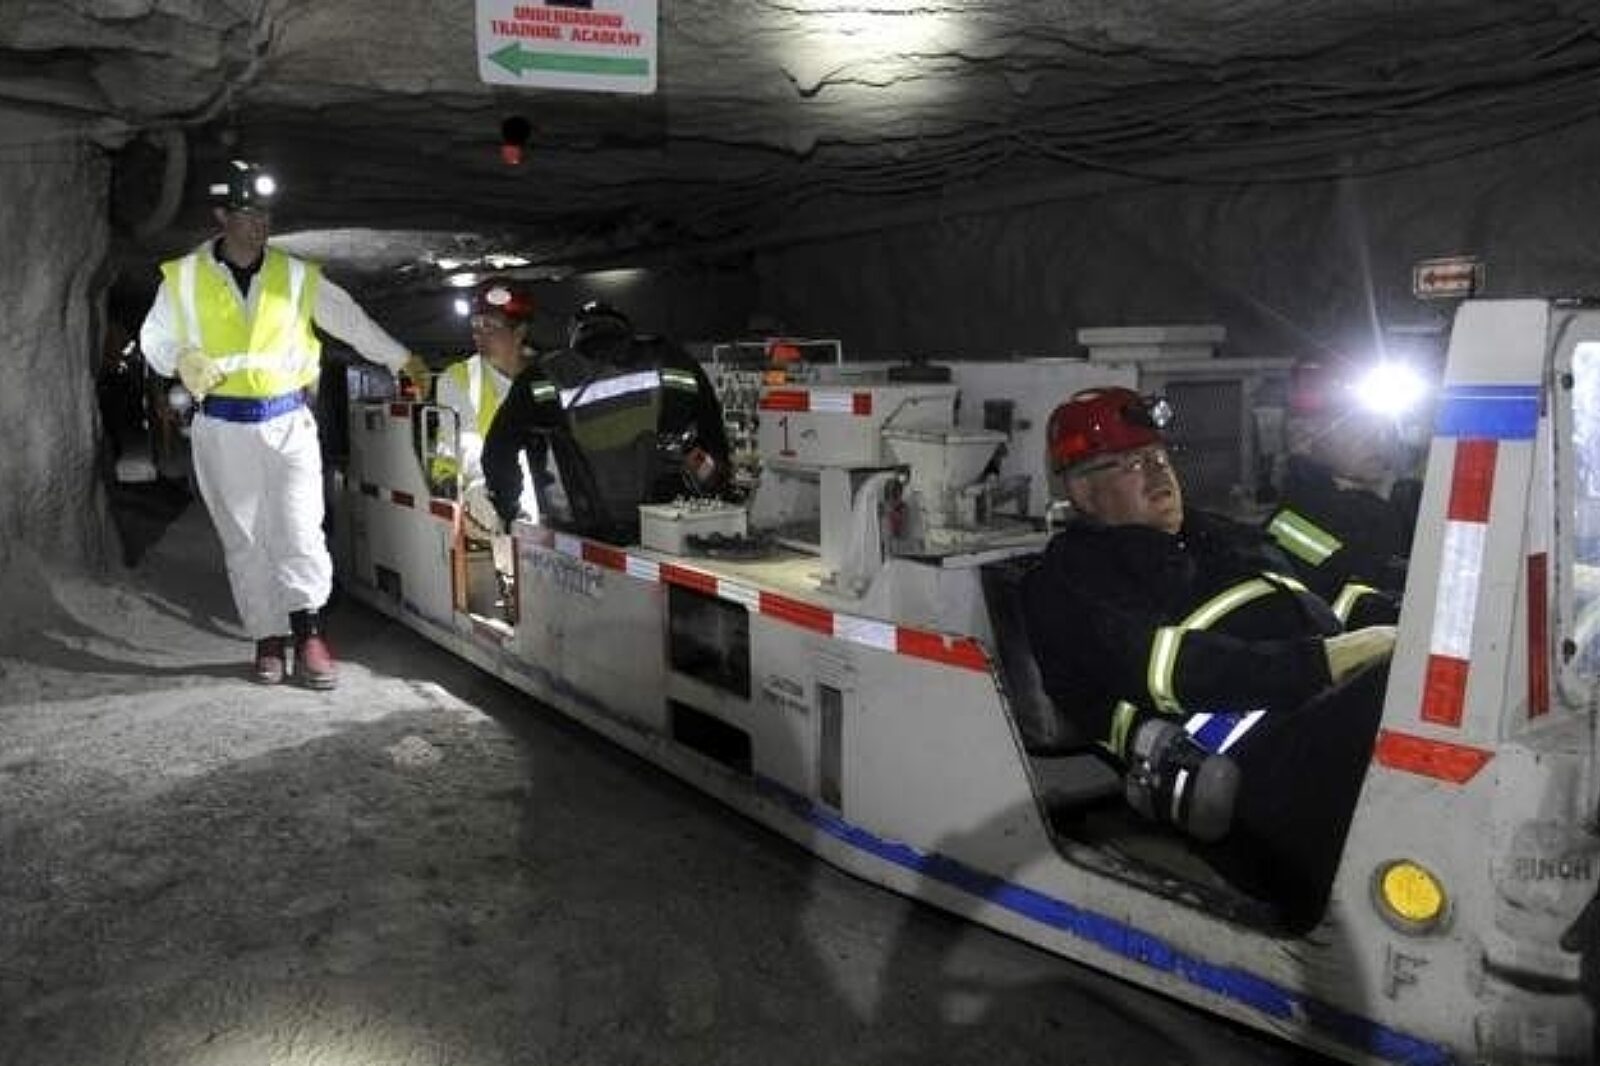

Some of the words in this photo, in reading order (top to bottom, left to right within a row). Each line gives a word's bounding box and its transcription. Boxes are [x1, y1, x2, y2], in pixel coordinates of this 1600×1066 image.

[513, 6, 622, 28] UNDERGROUND
[491, 20, 561, 40] TRAINING
[569, 27, 642, 47] ACADEMY
[779, 415, 797, 458] 1
